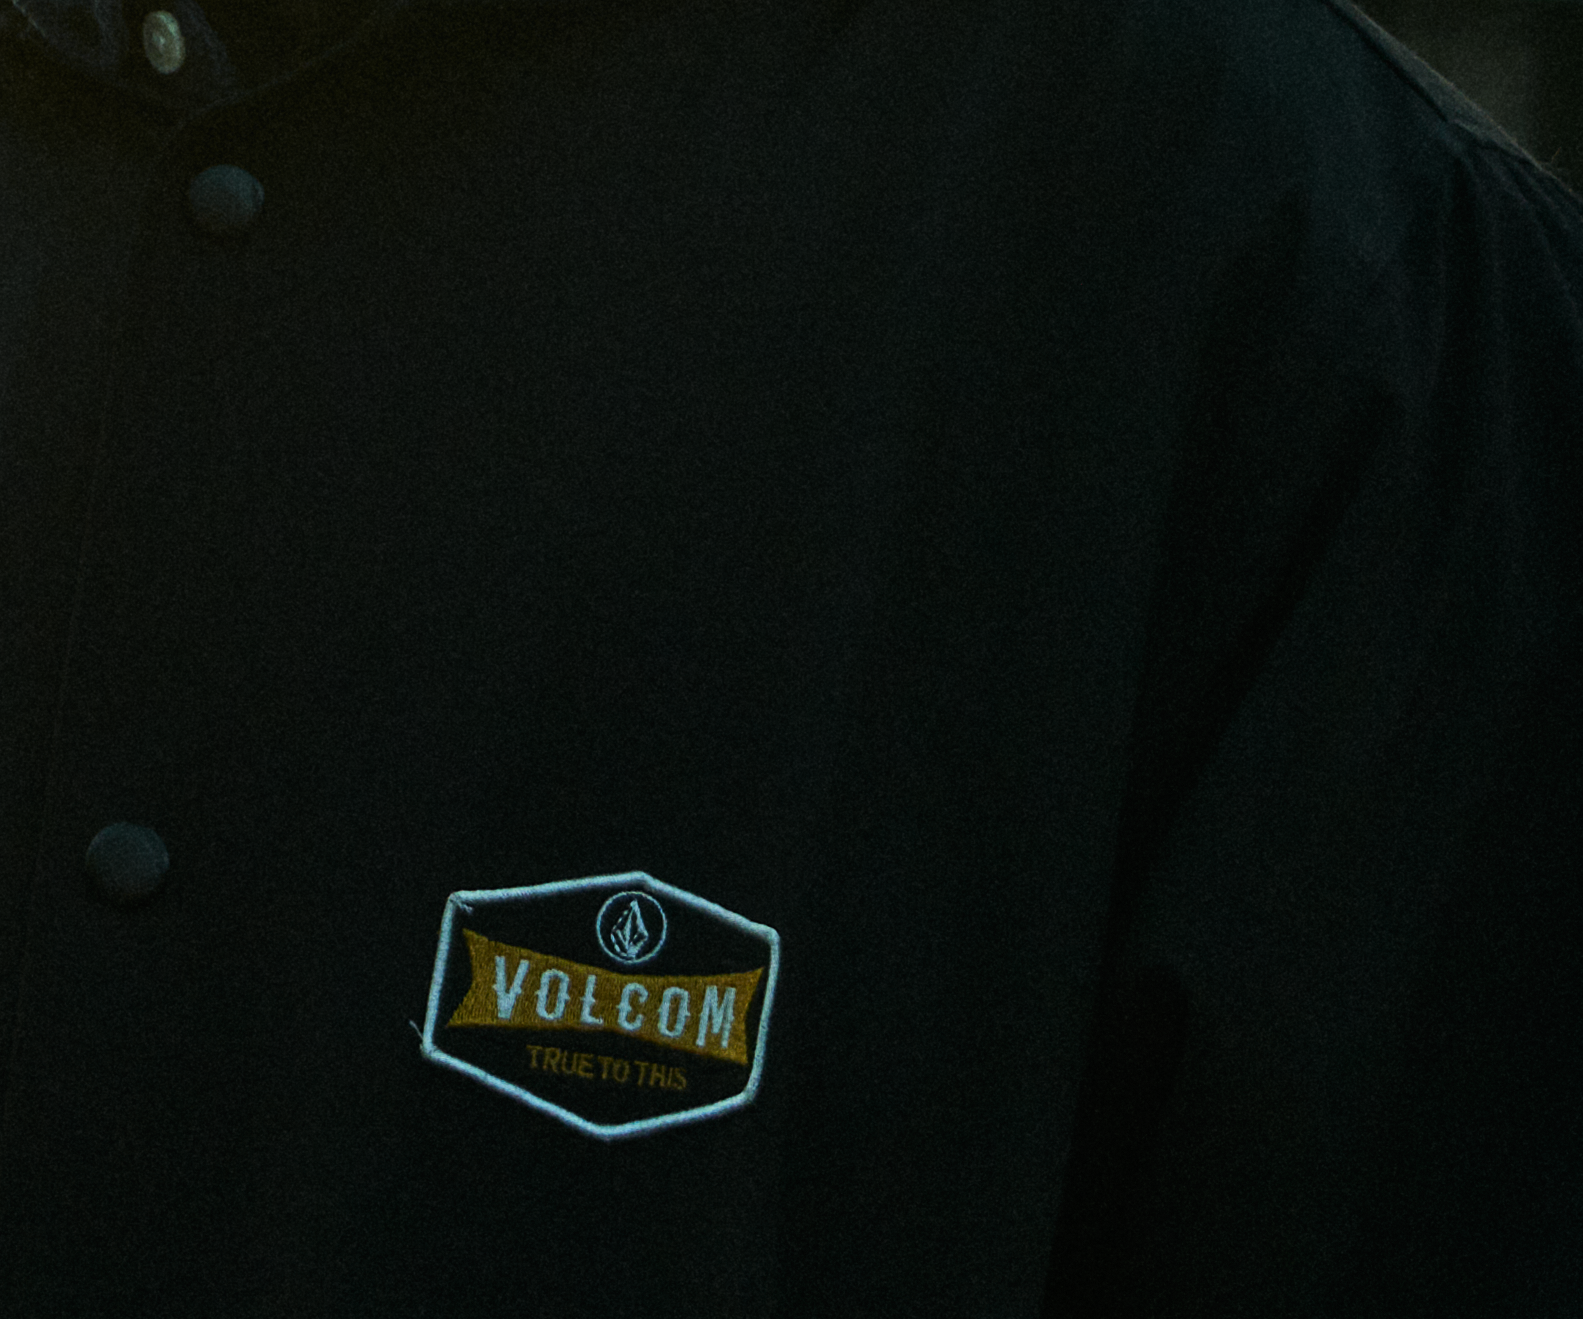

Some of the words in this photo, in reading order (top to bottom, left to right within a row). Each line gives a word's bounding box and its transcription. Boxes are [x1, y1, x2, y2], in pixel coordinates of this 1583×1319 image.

[492, 955, 736, 1048] VOLCOM
[527, 1045, 595, 1078] TRUE
[597, 1056, 631, 1082] TO
[634, 1061, 687, 1090] THIS
